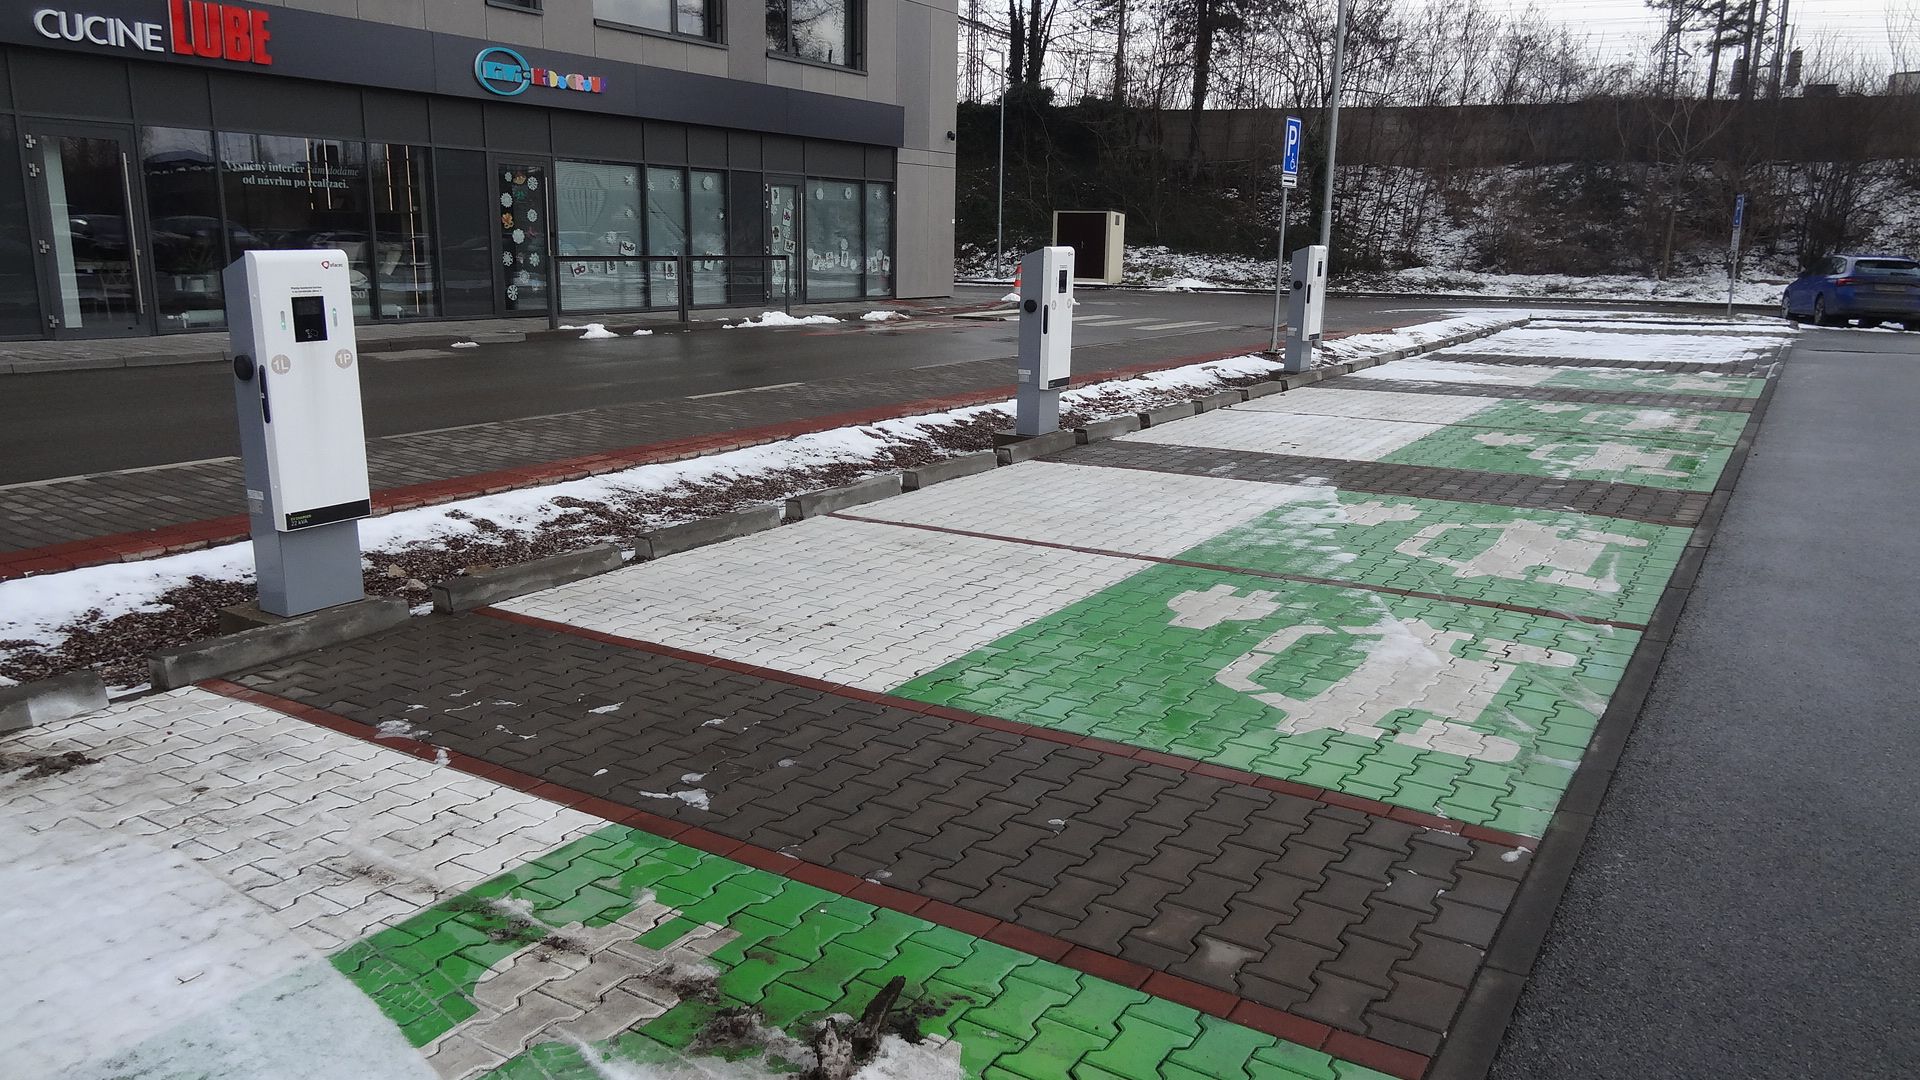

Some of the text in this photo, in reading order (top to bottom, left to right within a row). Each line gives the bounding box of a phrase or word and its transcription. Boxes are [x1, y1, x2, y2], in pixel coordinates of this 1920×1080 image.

[33, 0, 273, 66] CUCINE LUBE
[1287, 125, 1298, 157] P
[242, 174, 256, 185] od
[257, 174, 292, 187] návrhu
[293, 179, 307, 189] po
[273, 359, 289, 370] 1L
[338, 353, 352, 364] 1P
